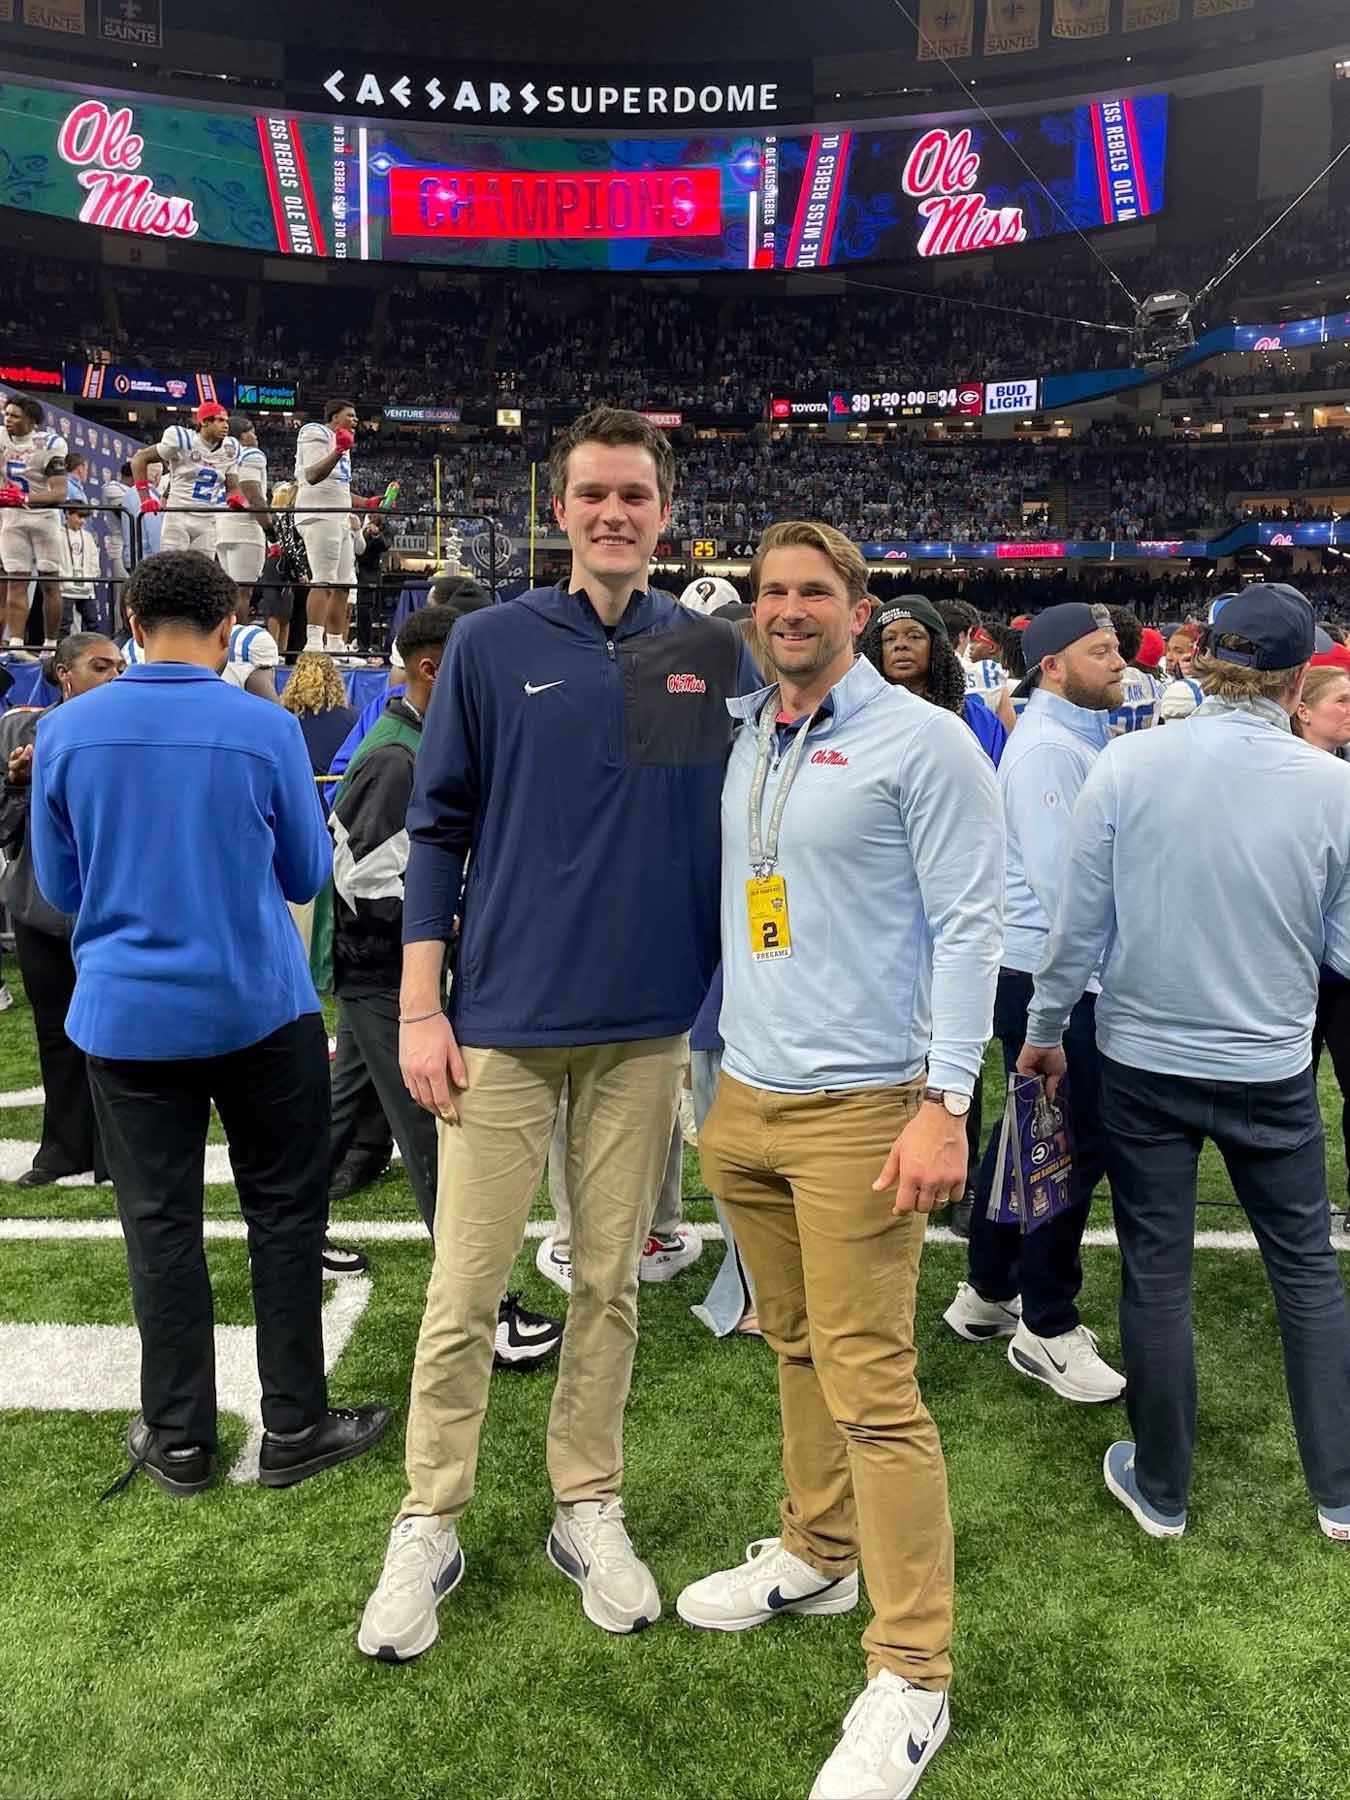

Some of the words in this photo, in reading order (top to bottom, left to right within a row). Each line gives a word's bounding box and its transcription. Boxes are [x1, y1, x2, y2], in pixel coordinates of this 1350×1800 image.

[104, 23, 156, 43] SAINTS
[1054, 21, 1106, 35] SAINTS
[986, 36, 1034, 51] SAINTS
[322, 69, 541, 115] CAESARS
[546, 83, 778, 114] SUPERDOME
[57, 100, 144, 170] Ole
[333, 134, 345, 153] OLE
[765, 147, 777, 165] OLE
[1106, 125, 1130, 172] REBELS
[273, 142, 299, 188] REBELS
[902, 128, 980, 197] Ole
[333, 160, 346, 194] REBELS
[764, 166, 776, 190] MISS
[811, 155, 836, 200] REBELS
[77, 168, 199, 238] Miss
[1113, 179, 1135, 206] OLE
[284, 195, 306, 221] OLE
[333, 195, 346, 220] MISS
[419, 177, 696, 234] CHAMPIONS
[764, 190, 776, 225] REBELS
[335, 221, 346, 238] OLE
[803, 203, 826, 239] MISS
[917, 193, 1027, 257] Miss
[763, 231, 775, 248] OLE
[797, 243, 818, 268] OLE
[259, 396, 295, 407] Federal
[851, 394, 871, 412] 39
[881, 391, 926, 407] 20:00
[937, 389, 958, 407] 34
[995, 384, 1027, 397] BUD
[384, 409, 424, 418] VENTURE
[425, 410, 458, 419] GLOBAL
[791, 403, 828, 413] TOYOTA
[988, 397, 1033, 410] LIGHT
[6, 461, 30, 494] 5
[192, 468, 218, 501] 2
[694, 541, 714, 557] 25
[667, 674, 684, 693] Ole
[681, 674, 706, 693] Miss
[810, 750, 828, 765] Ole
[826, 750, 849, 766] Miss
[762, 921, 779, 949] 2
[756, 949, 789, 960] PREGAME
